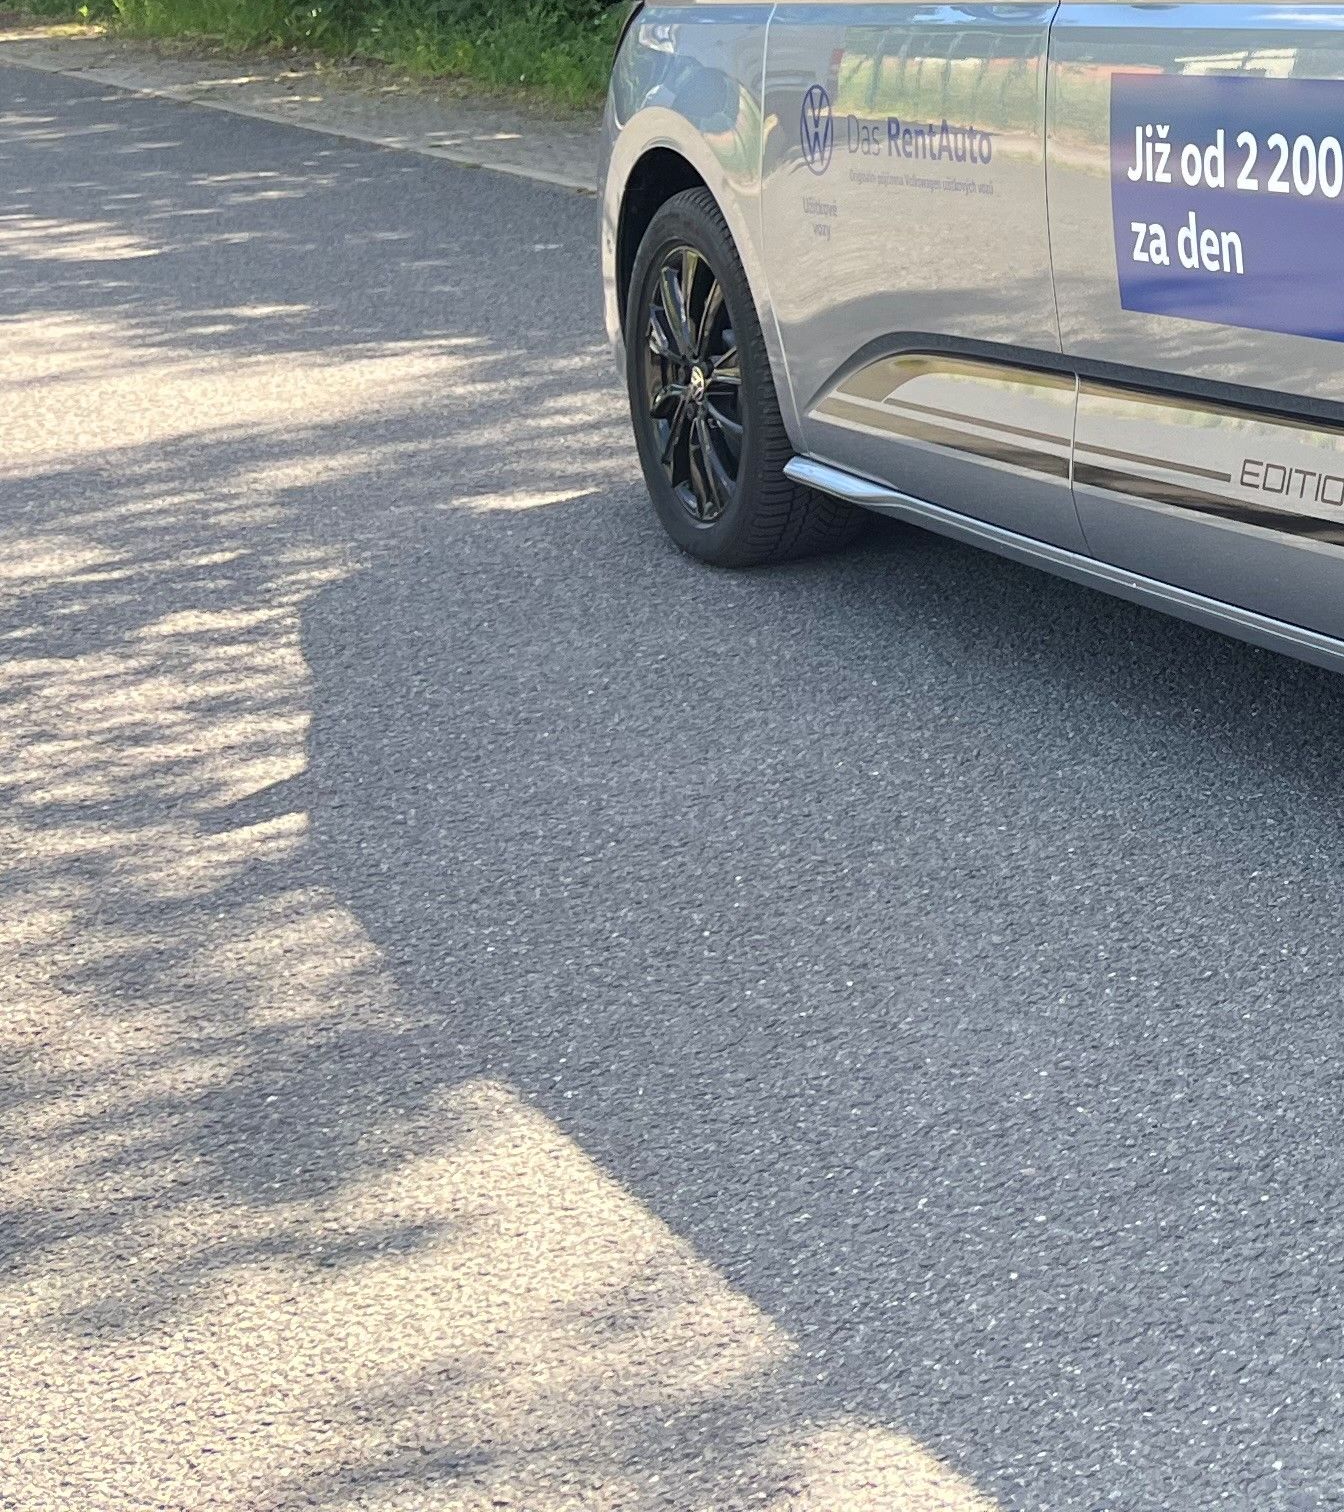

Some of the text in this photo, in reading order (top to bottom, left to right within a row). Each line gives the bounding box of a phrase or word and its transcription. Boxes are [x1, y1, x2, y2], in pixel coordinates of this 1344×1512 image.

[847, 114, 993, 165] Das RentAuto
[1127, 124, 1172, 184] Již
[1180, 129, 1226, 189] od
[1130, 211, 1245, 274] za den
